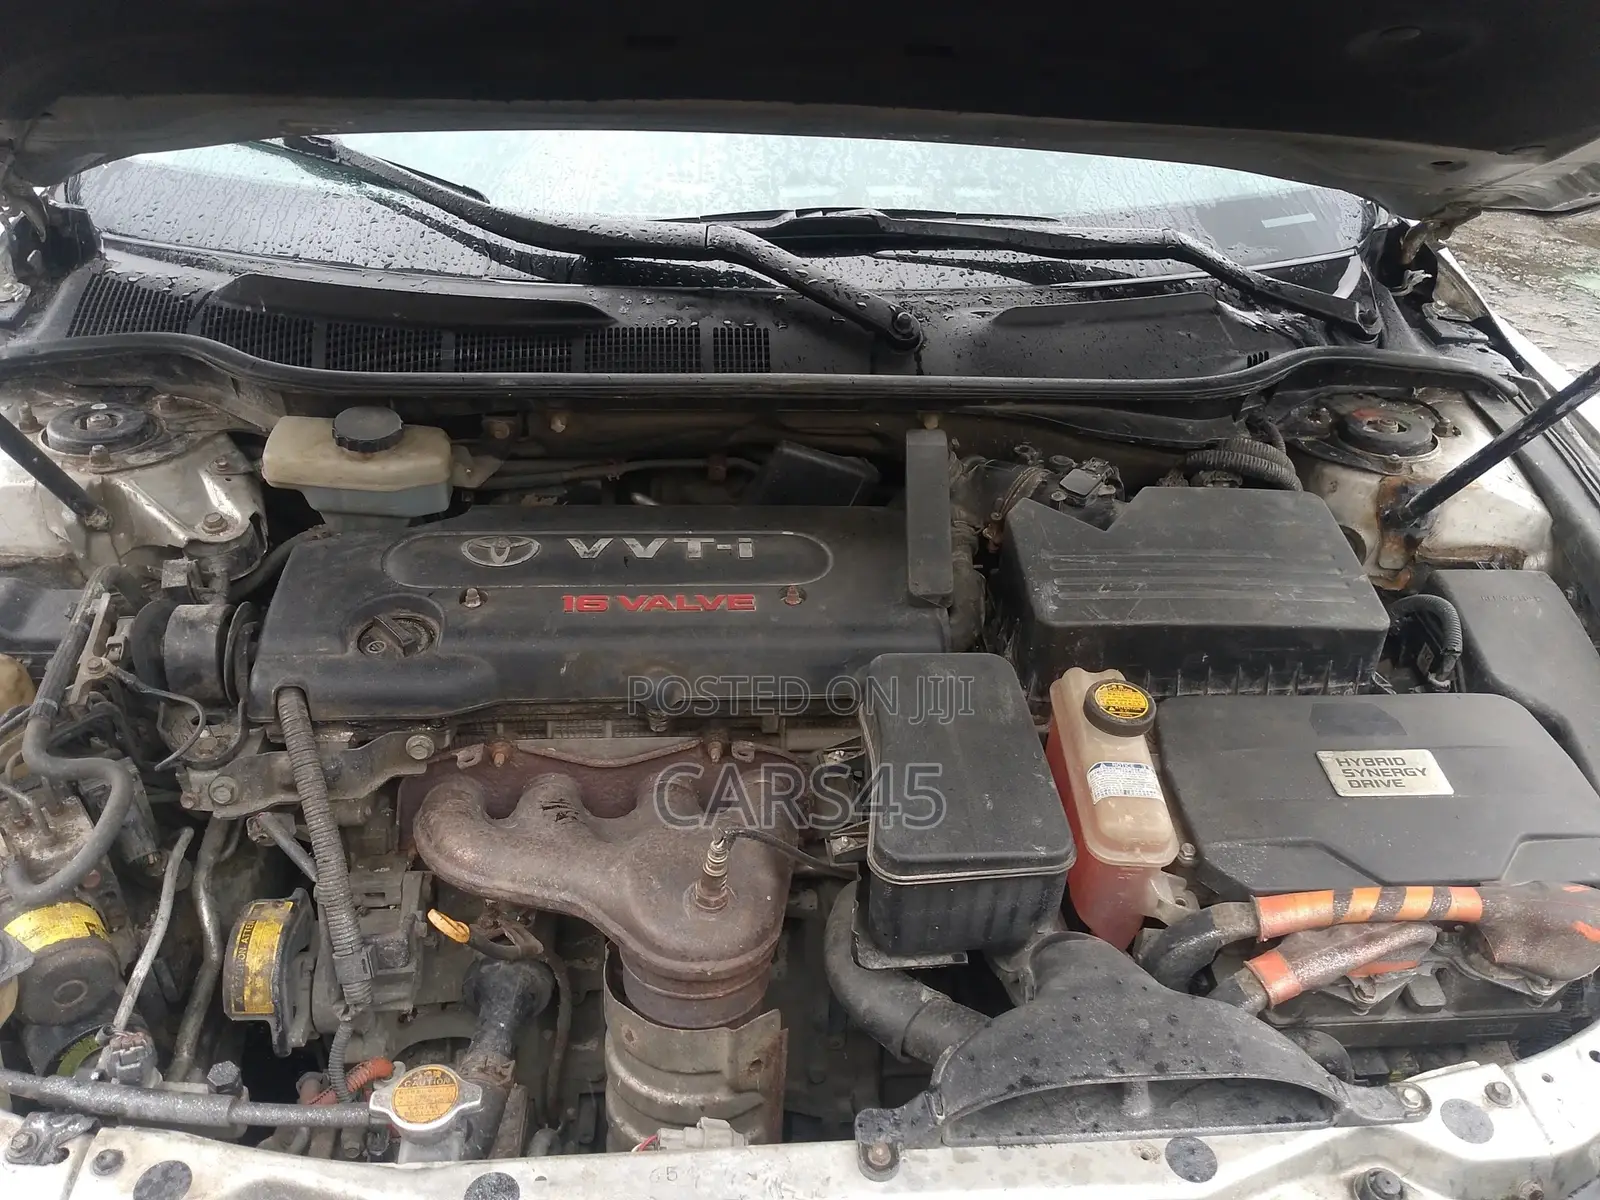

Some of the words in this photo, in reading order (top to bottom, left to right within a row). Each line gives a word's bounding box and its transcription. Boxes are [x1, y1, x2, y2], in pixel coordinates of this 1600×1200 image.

[566, 537, 754, 559] VVT-i
[562, 595, 610, 612] 16
[616, 594, 757, 612] VALVE
[1335, 757, 1406, 767] HYBRID
[1341, 767, 1427, 778] SYNERGY
[1347, 779, 1406, 788] DRIVE
[404, 1077, 451, 1087] CAUTION
